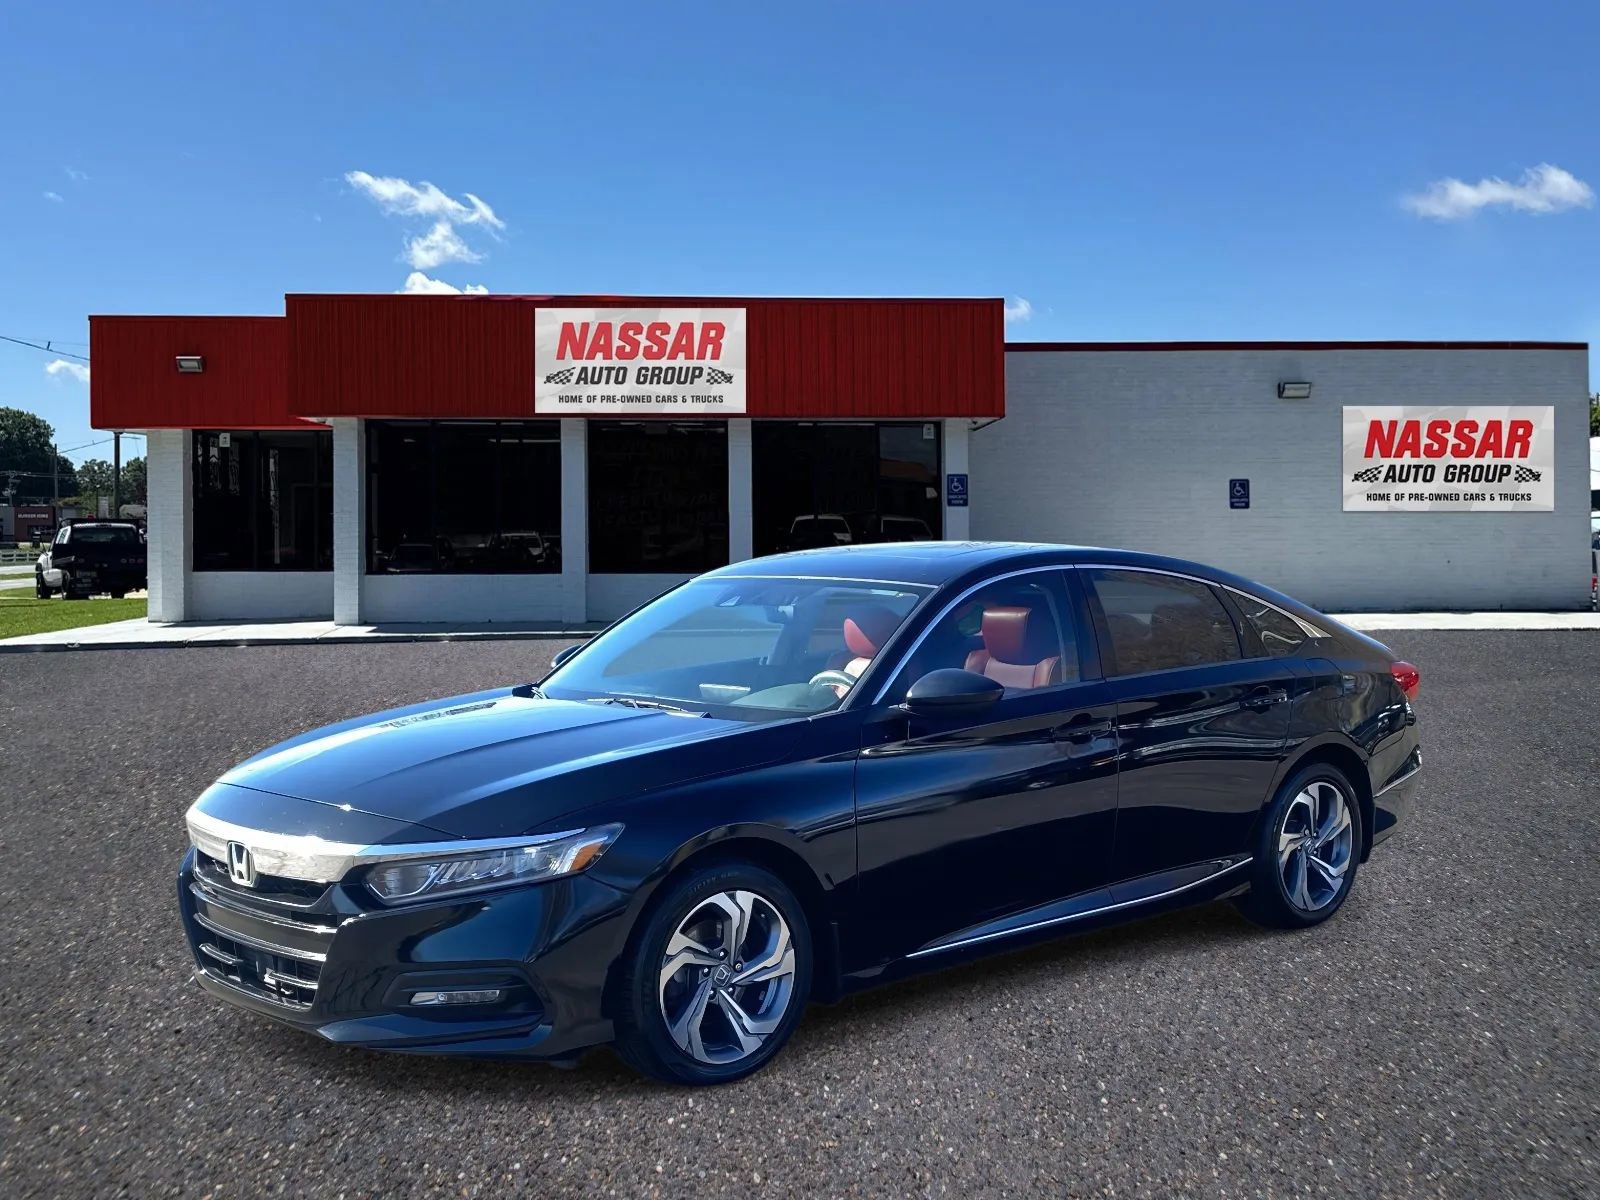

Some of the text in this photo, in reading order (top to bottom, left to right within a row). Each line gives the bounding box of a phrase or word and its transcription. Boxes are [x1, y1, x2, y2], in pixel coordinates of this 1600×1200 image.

[556, 321, 725, 361] NASSAR
[574, 366, 704, 385] AUTO GROUP
[558, 394, 724, 404] HOME OF PRE-OWNED CARS & TRUCKS
[1364, 420, 1534, 459] NASSAR
[1382, 464, 1512, 483] AUTO GROUP
[1366, 492, 1532, 502] HOME OF PRE-OWNED CARS & TRUCKS
